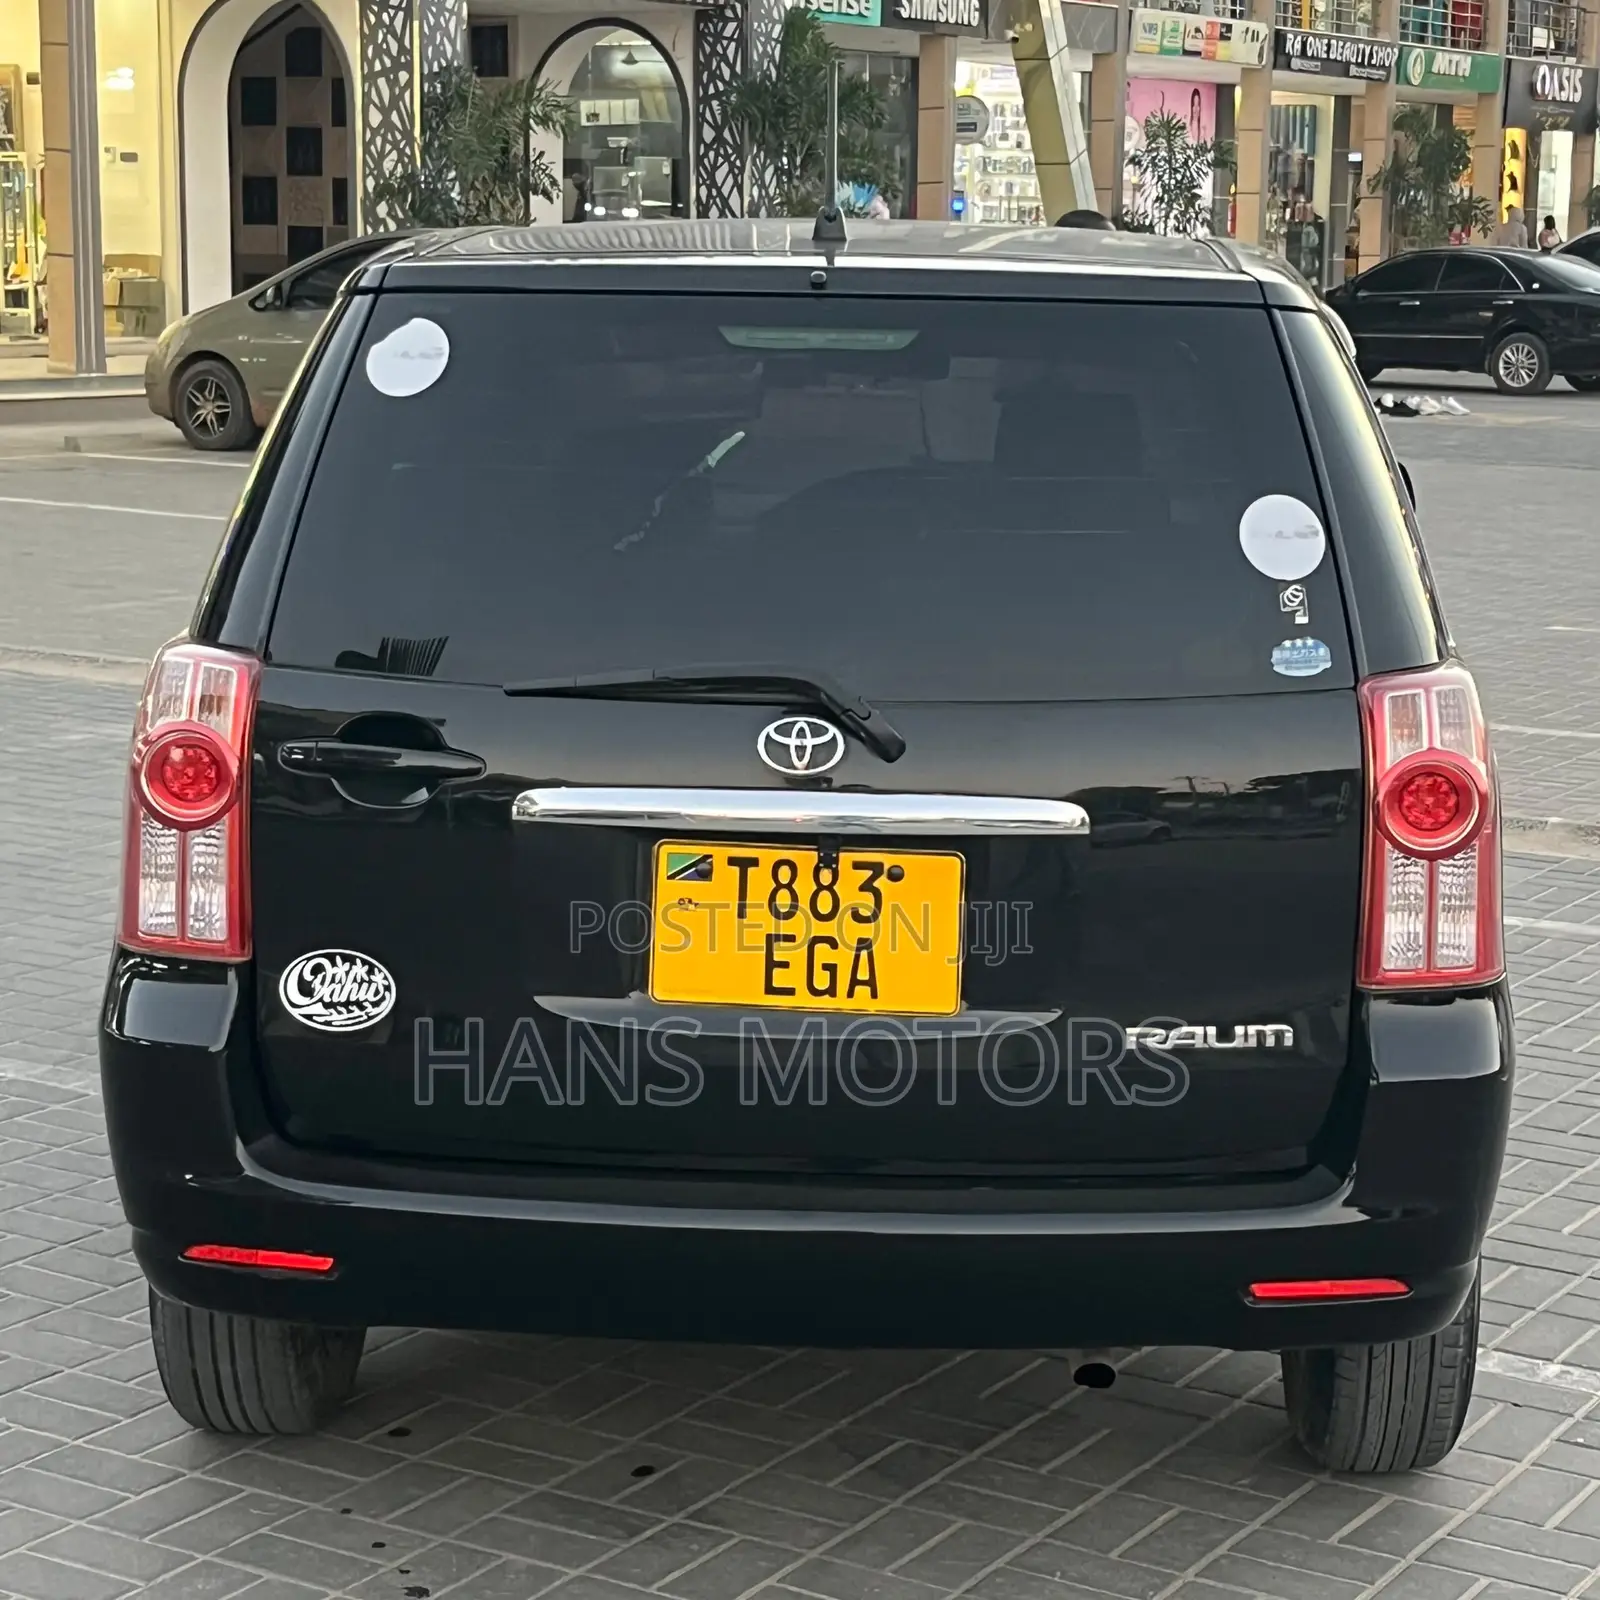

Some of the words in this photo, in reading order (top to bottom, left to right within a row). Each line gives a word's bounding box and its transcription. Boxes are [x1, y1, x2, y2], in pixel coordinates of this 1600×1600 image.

[900, 0, 980, 27] SAMSUNG
[1329, 39, 1371, 66] BEAUTY
[1371, 45, 1399, 68] SHOP
[1536, 64, 1583, 103] OASIS
[727, 855, 885, 924] T883
[764, 933, 878, 999] EGA
